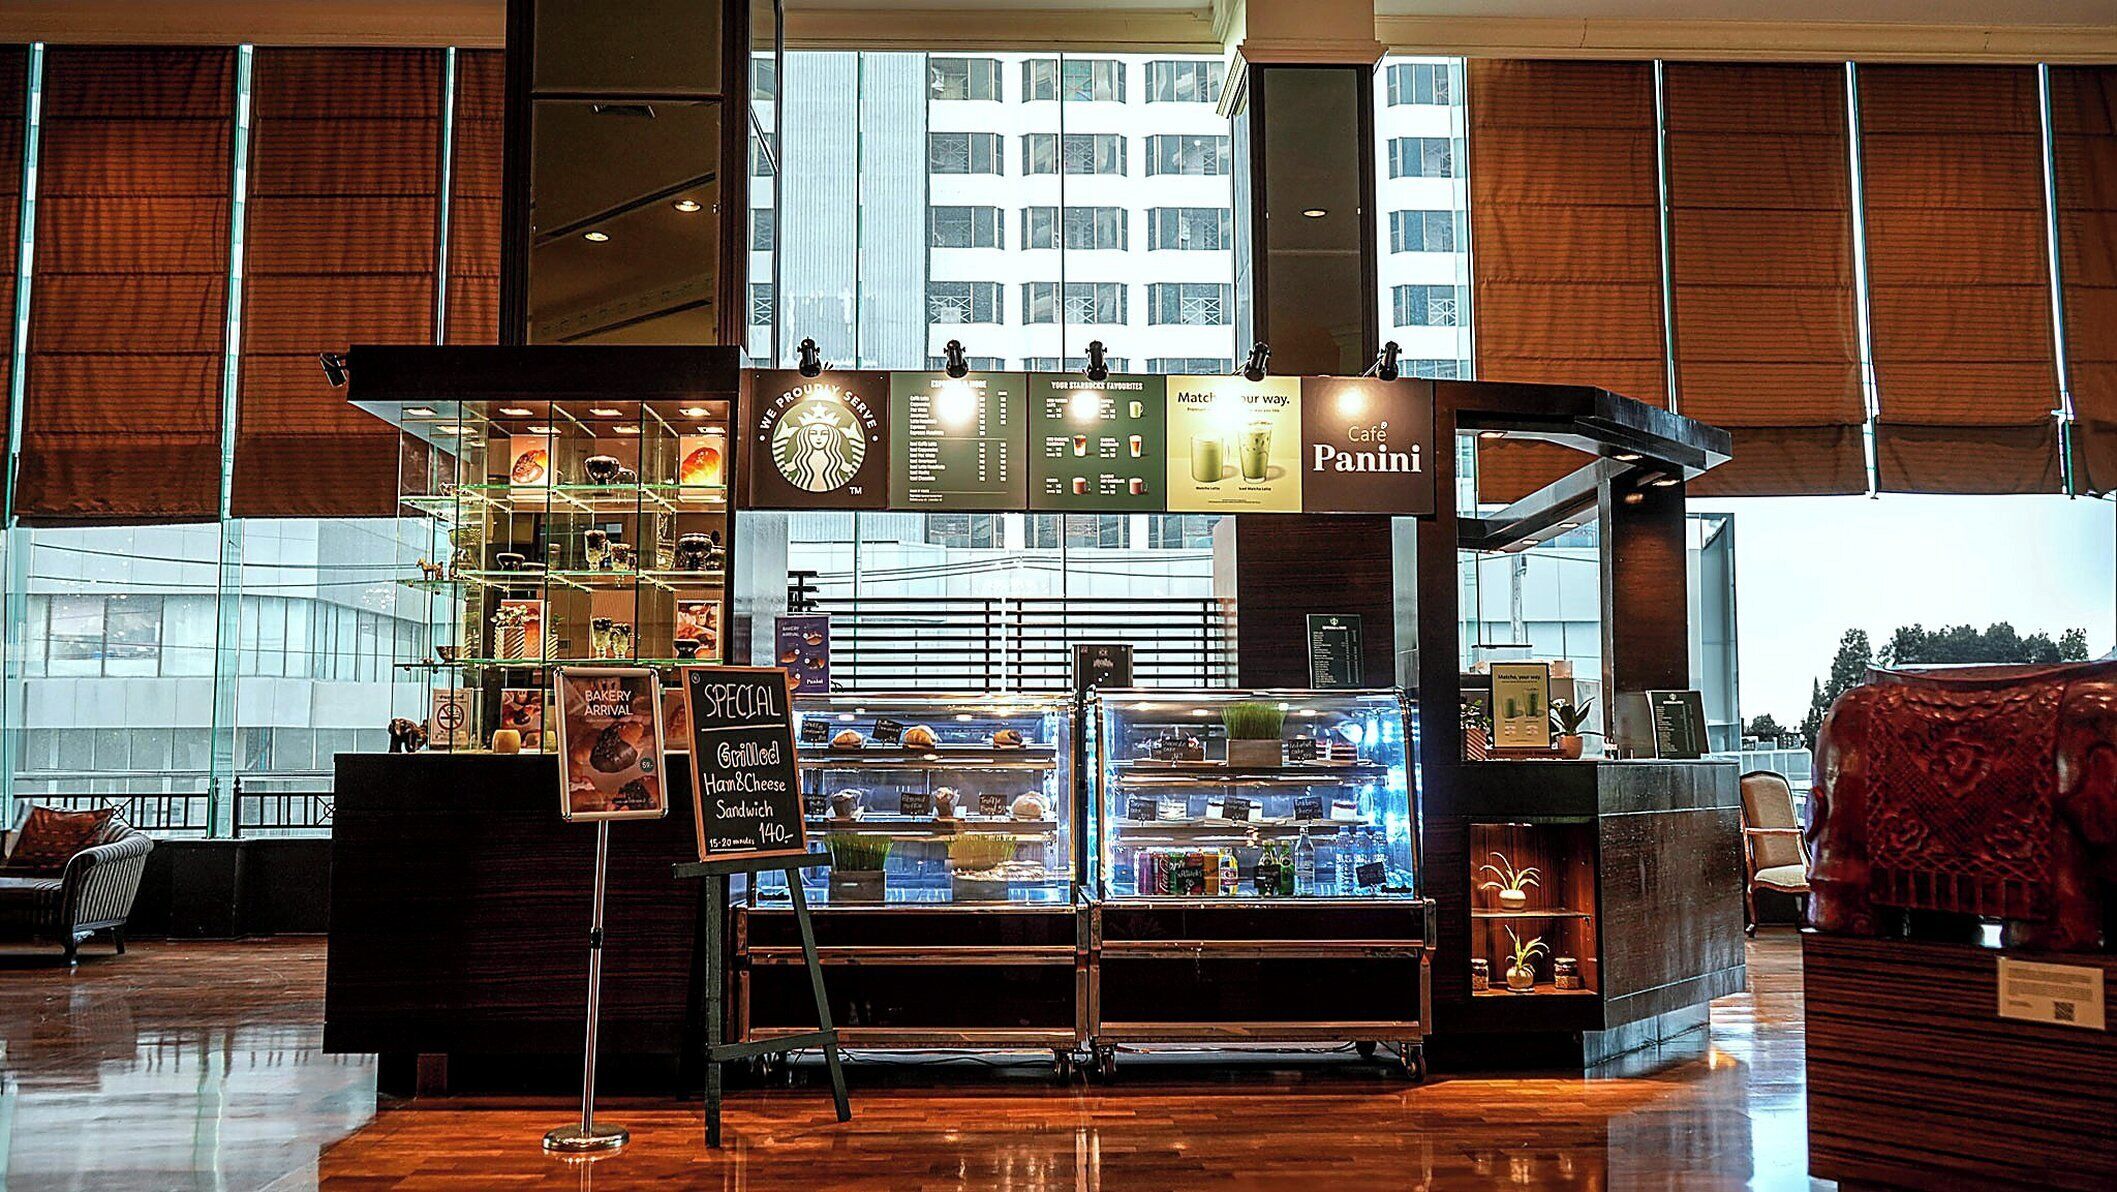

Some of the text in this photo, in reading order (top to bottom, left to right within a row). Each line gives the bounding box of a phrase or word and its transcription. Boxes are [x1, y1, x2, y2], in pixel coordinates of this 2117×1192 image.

[1051, 381, 1143, 390] YOUR STARBUCKS FAVOURITES
[760, 384, 877, 429] WE PROUDLY SERVE
[1262, 395, 1290, 407] way.
[1313, 444, 1422, 472] Panini
[849, 487, 862, 495] TM
[584, 690, 632, 702] BAKERY
[704, 683, 781, 719] SPECIAL
[584, 704, 634, 716] ARRIVAL
[717, 740, 780, 769] Grilled
[703, 772, 787, 796] Ham&Cheese
[716, 799, 774, 819] Sandwich
